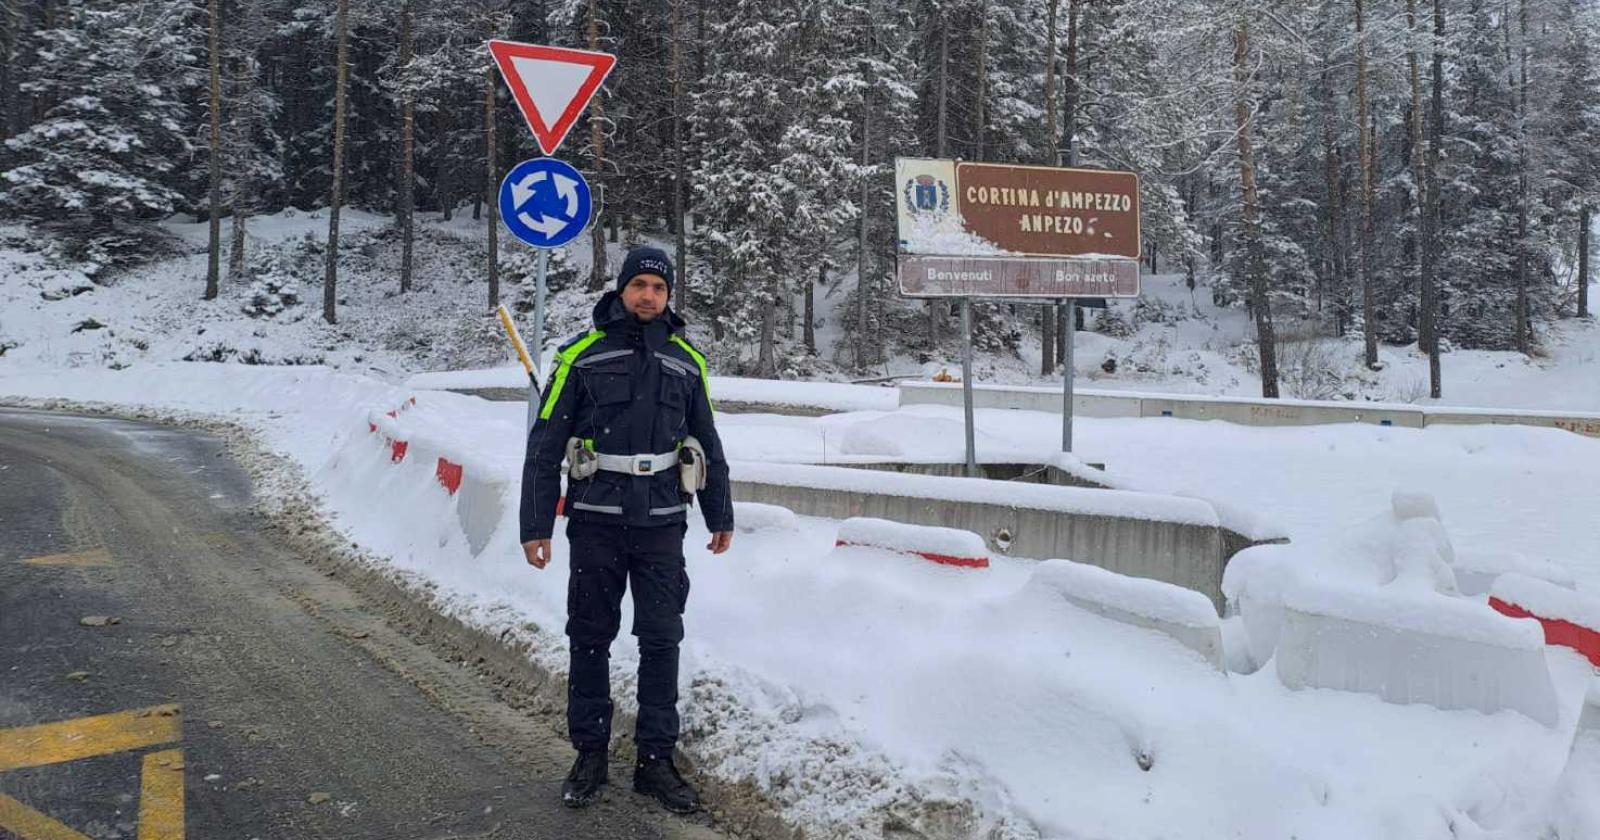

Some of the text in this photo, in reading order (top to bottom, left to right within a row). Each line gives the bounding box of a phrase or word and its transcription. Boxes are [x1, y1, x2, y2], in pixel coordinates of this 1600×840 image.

[966, 186, 1132, 212] CORTINA d'AMPEZZO
[1021, 214, 1083, 235] ANPEZO
[927, 267, 992, 281] Benvenuti
